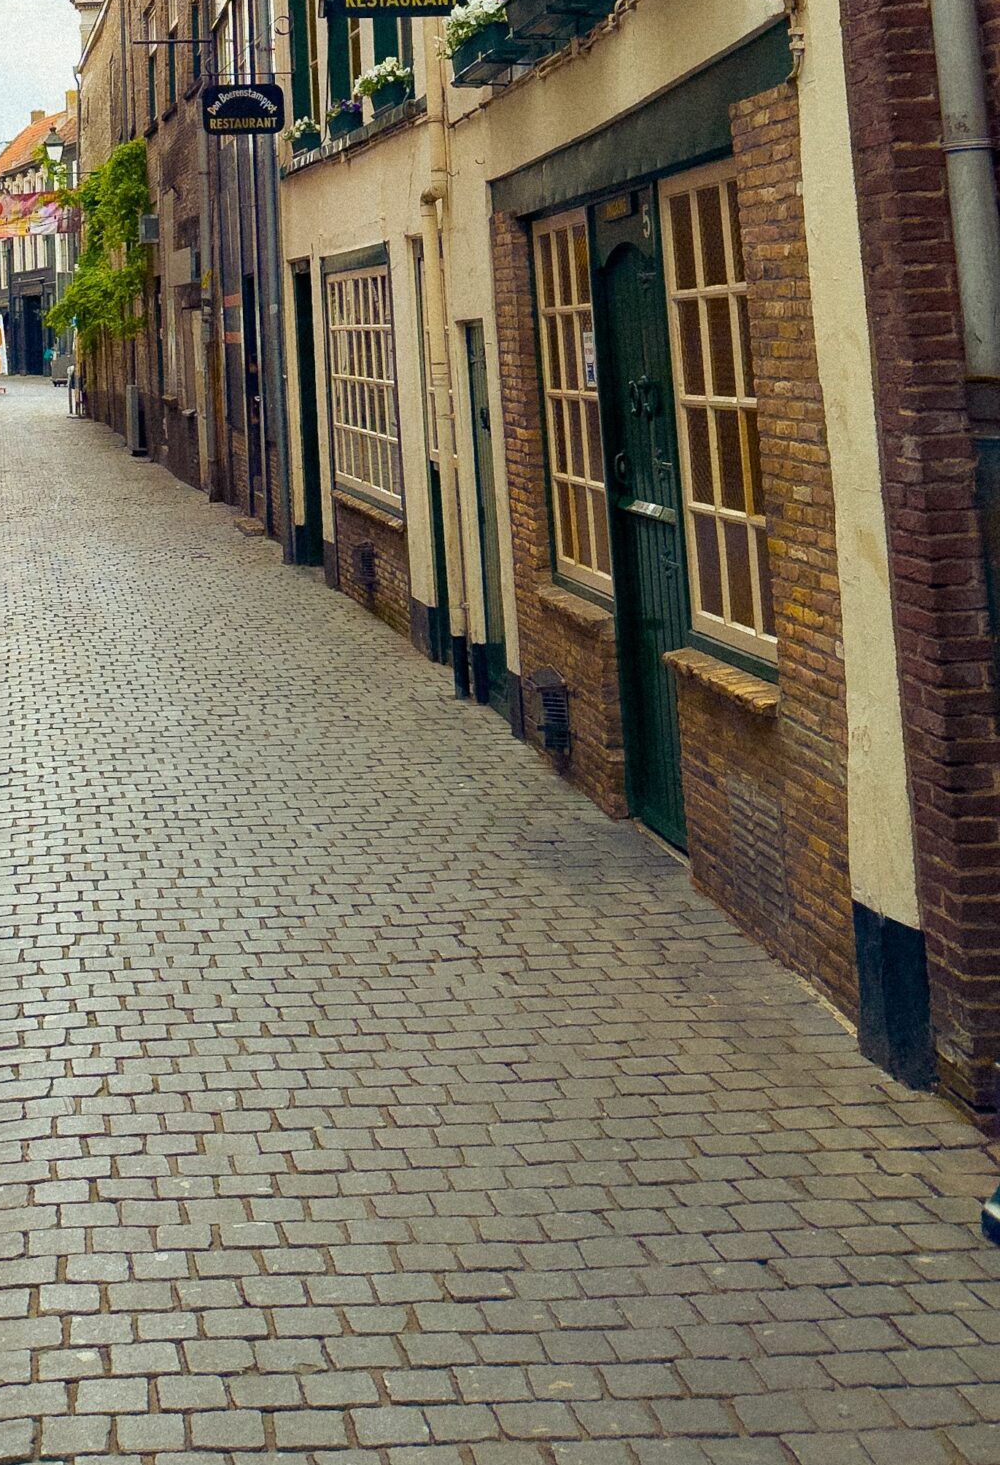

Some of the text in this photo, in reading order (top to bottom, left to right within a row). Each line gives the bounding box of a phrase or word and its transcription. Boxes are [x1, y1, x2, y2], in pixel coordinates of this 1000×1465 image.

[207, 88, 278, 115] Den Boerenstamppot
[210, 117, 277, 129] RESTAURANT
[643, 204, 650, 238] 5
